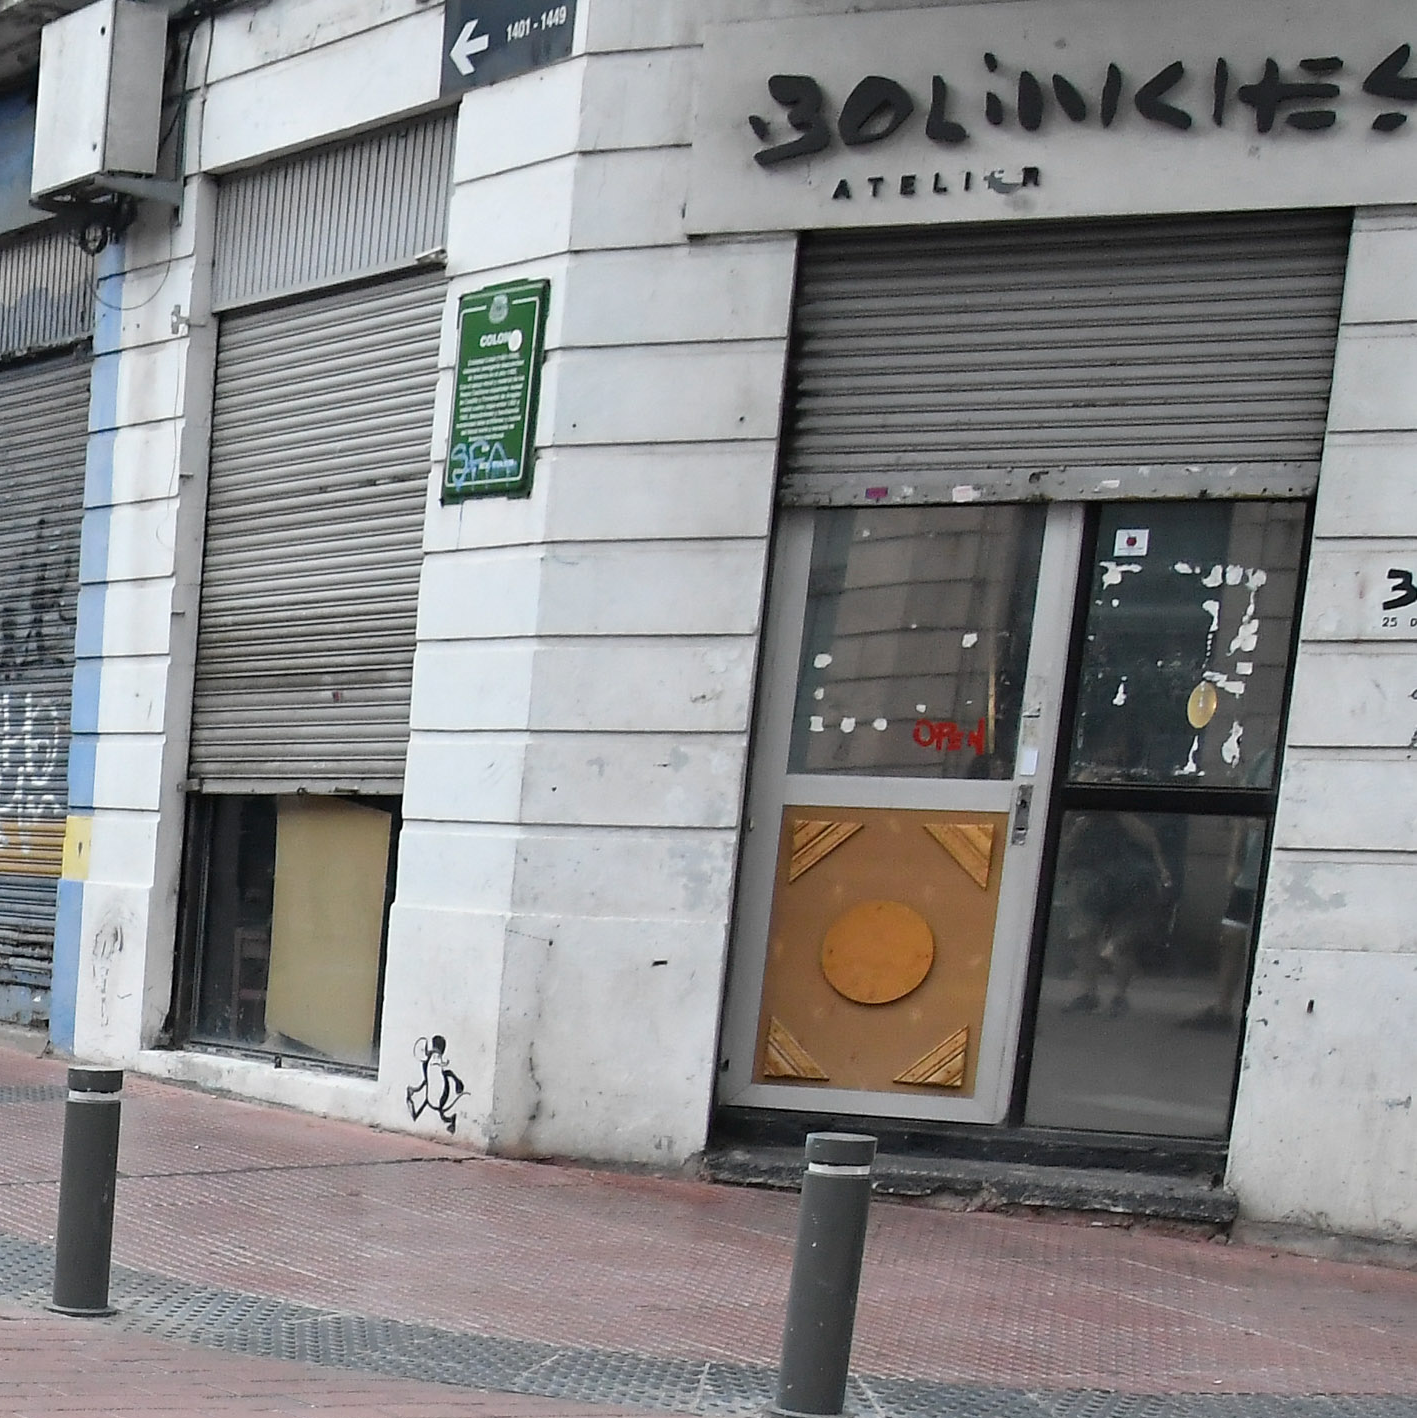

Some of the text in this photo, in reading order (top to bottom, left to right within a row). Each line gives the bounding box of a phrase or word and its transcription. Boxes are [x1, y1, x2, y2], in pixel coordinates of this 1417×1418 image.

[506, 17, 531, 42] 1401
[540, 5, 567, 31] 1449
[832, 166, 1040, 200] ATELIR
[1382, 617, 1398, 628] 25
[913, 717, 985, 756] OPEN
